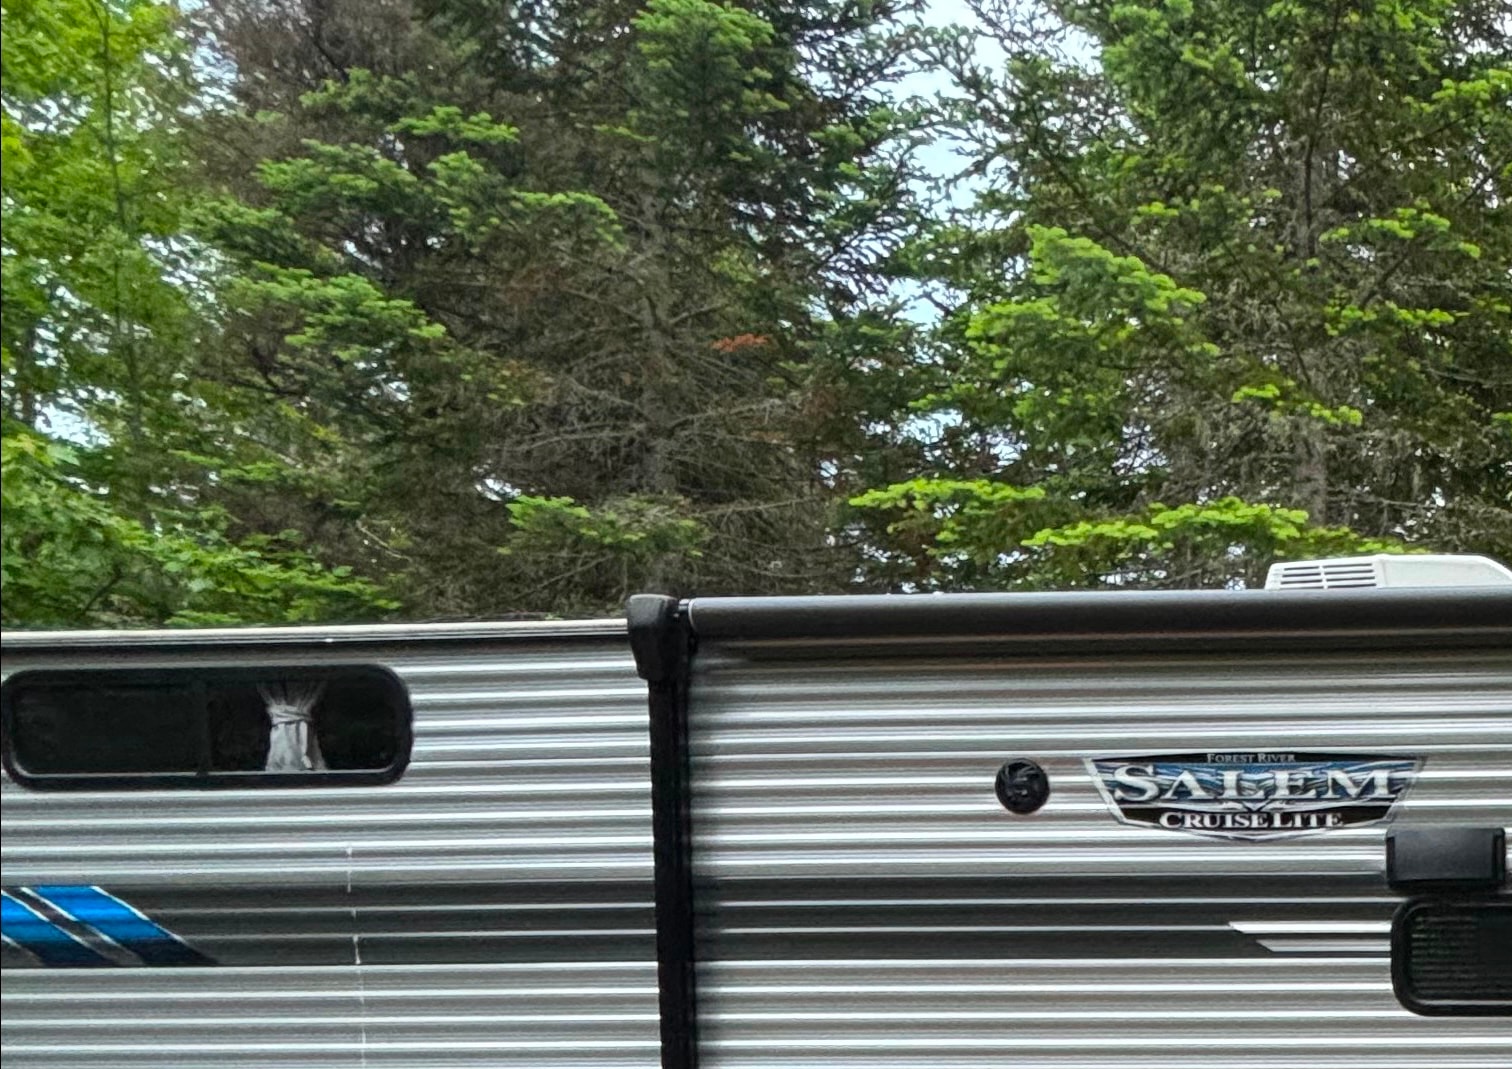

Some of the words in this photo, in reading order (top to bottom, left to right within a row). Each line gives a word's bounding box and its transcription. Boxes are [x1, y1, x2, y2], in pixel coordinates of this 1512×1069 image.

[1206, 752, 1256, 764] FOREST
[1257, 751, 1297, 763] RIVER
[1113, 764, 1397, 801] SALEM
